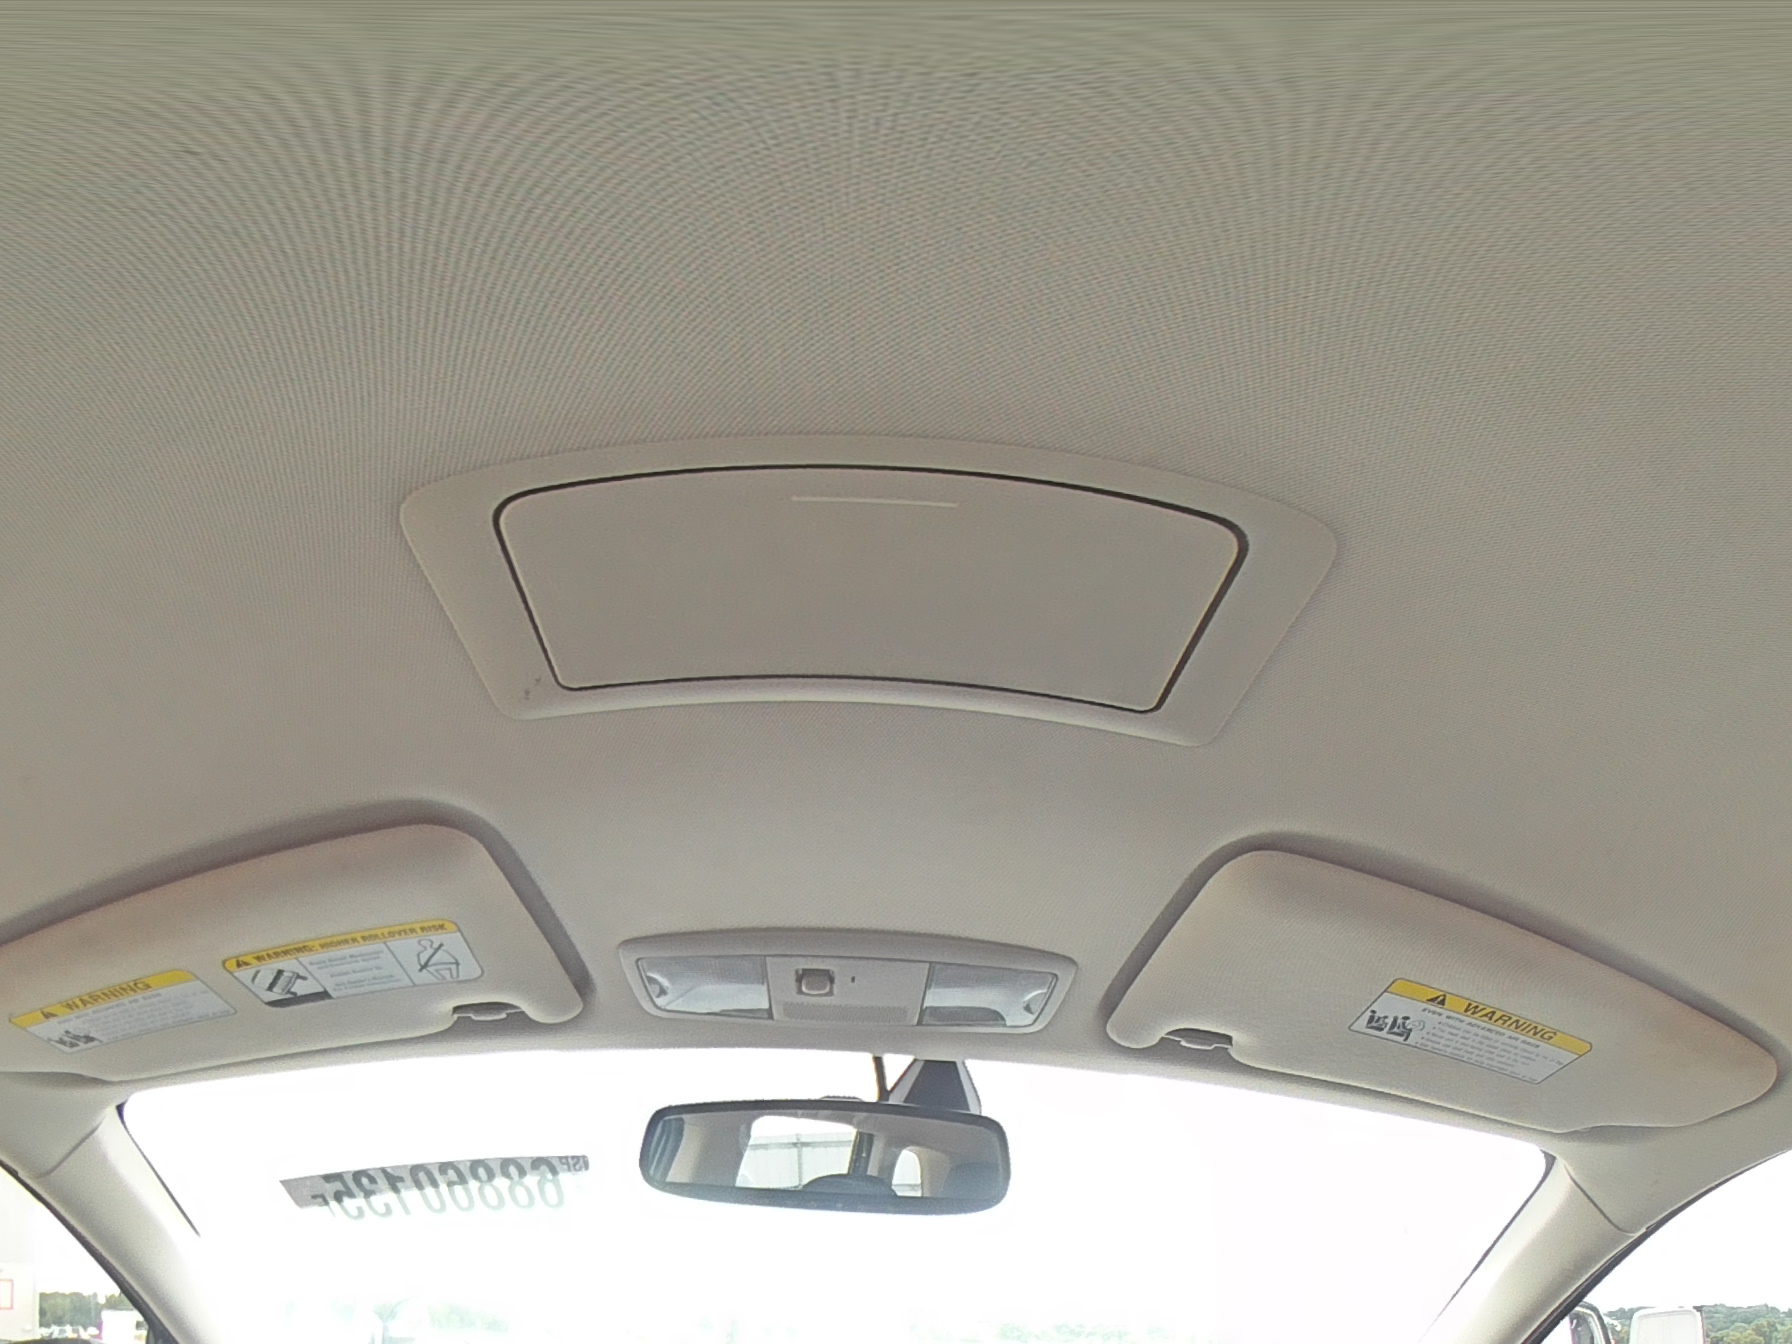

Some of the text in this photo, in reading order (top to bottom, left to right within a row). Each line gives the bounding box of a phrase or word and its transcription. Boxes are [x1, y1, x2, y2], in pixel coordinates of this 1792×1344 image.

[255, 922, 447, 963] WARNING: HIGHER ROLLOVER RISK
[60, 980, 153, 1012] WARNING
[1463, 1002, 1557, 1042] WARNING
